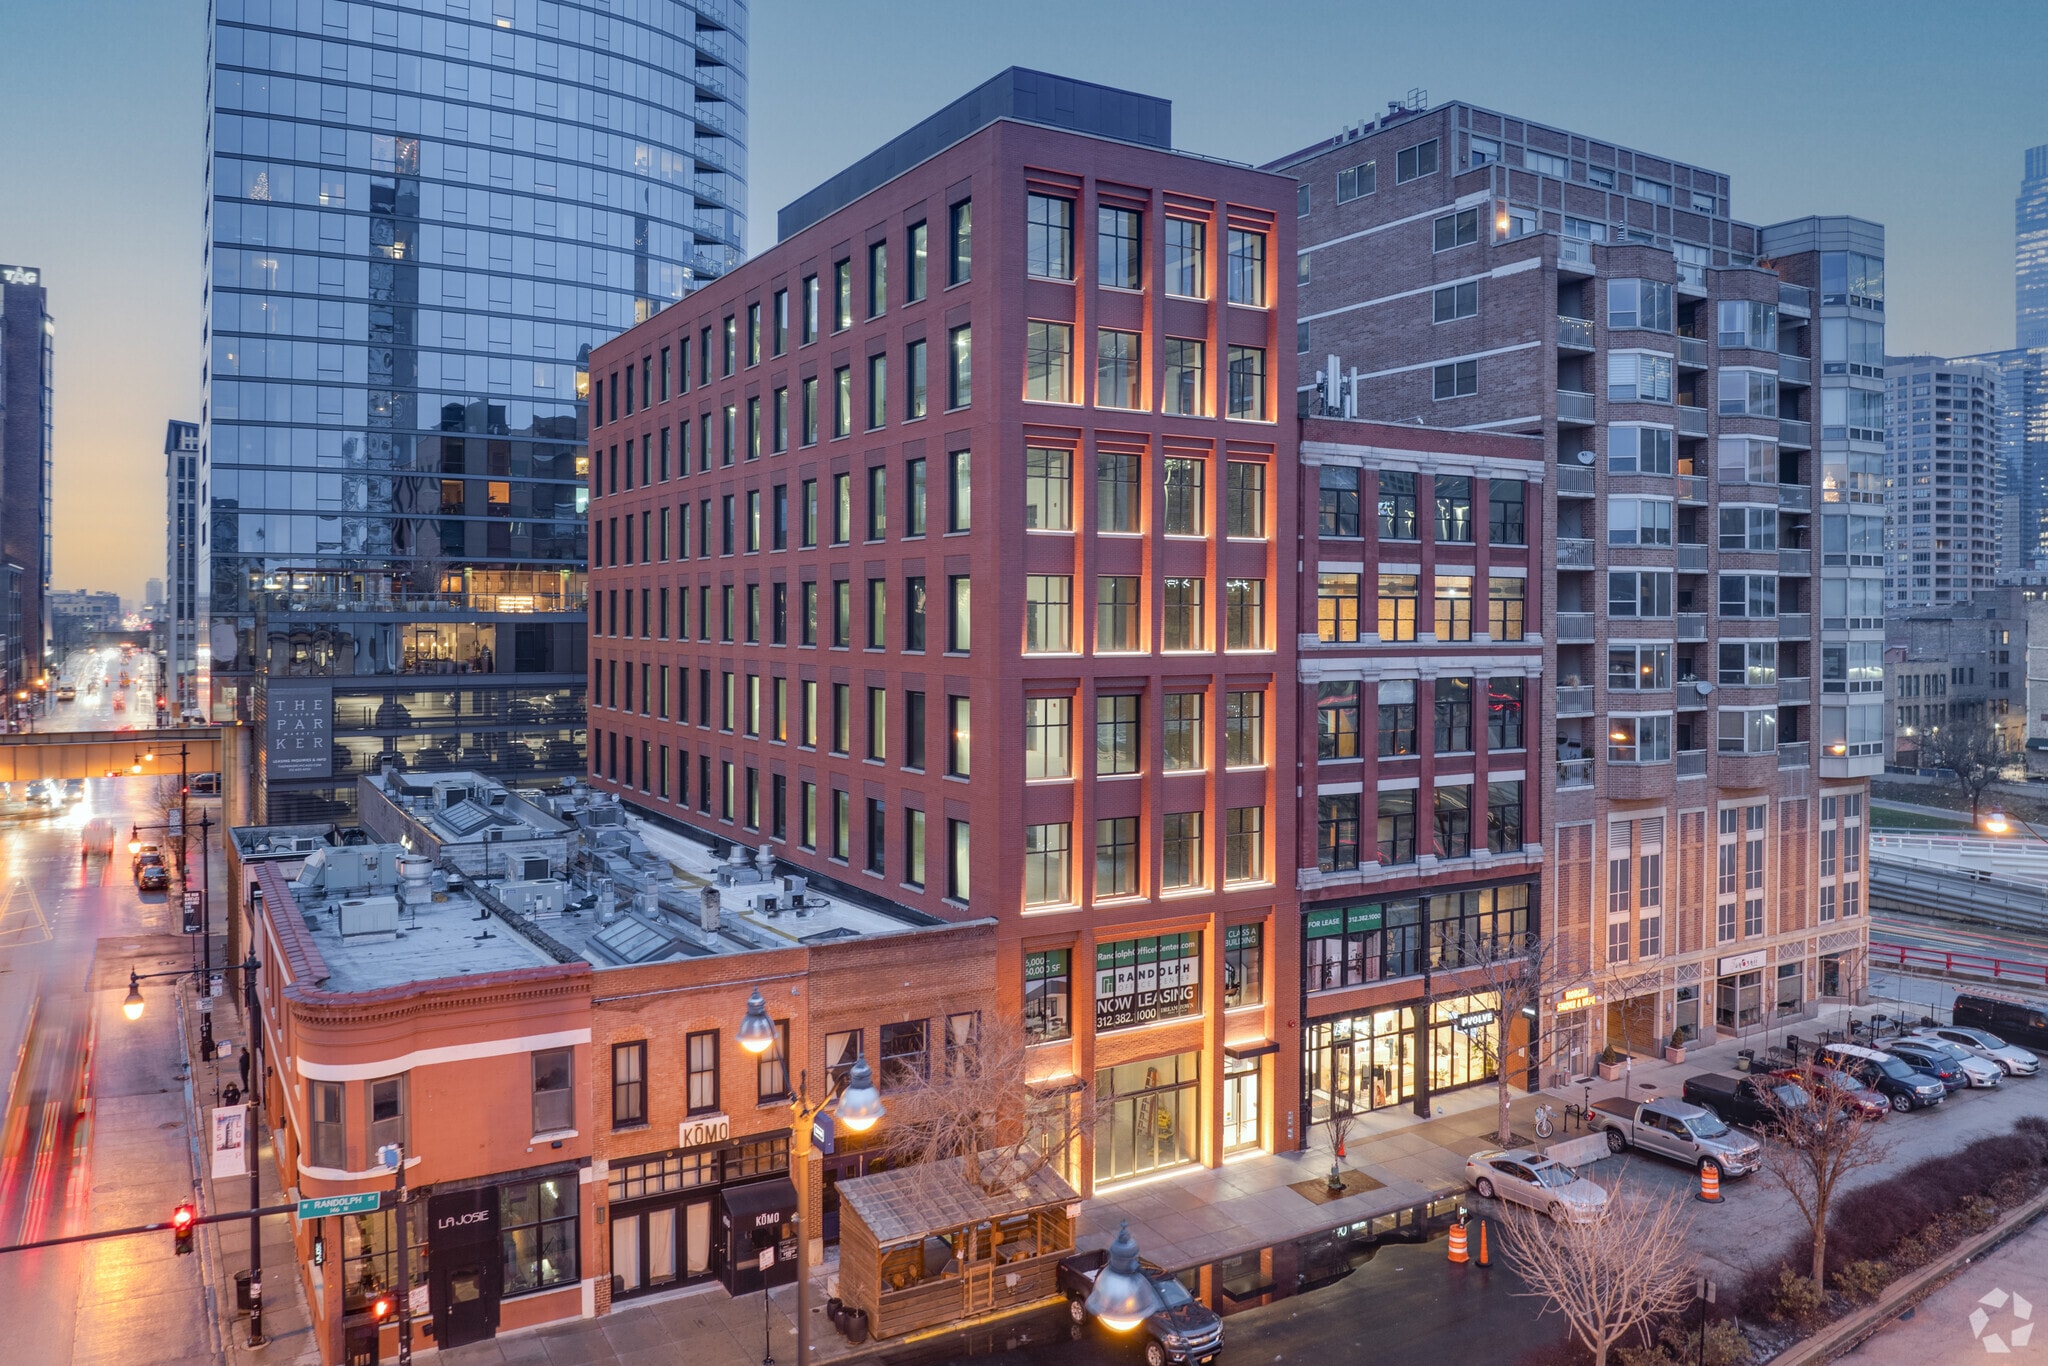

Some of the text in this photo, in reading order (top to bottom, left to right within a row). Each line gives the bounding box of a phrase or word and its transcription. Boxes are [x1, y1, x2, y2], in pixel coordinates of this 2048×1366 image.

[275, 700, 323, 711] THE
[1308, 920, 1321, 928] FOR
[1321, 917, 1340, 926] LEASE
[1228, 928, 1250, 938] CLASS
[1051, 963, 1061, 972] SF
[1118, 963, 1190, 983] RANDOLPH
[1097, 986, 1194, 1014] NOW LEASING
[1461, 1012, 1493, 1027] PVOLVE
[684, 1122, 728, 1148] KŌMO
[314, 1197, 362, 1209] RANDOLPH
[438, 1210, 489, 1230] LA JOSIE
[755, 1212, 780, 1227] KŌMO
